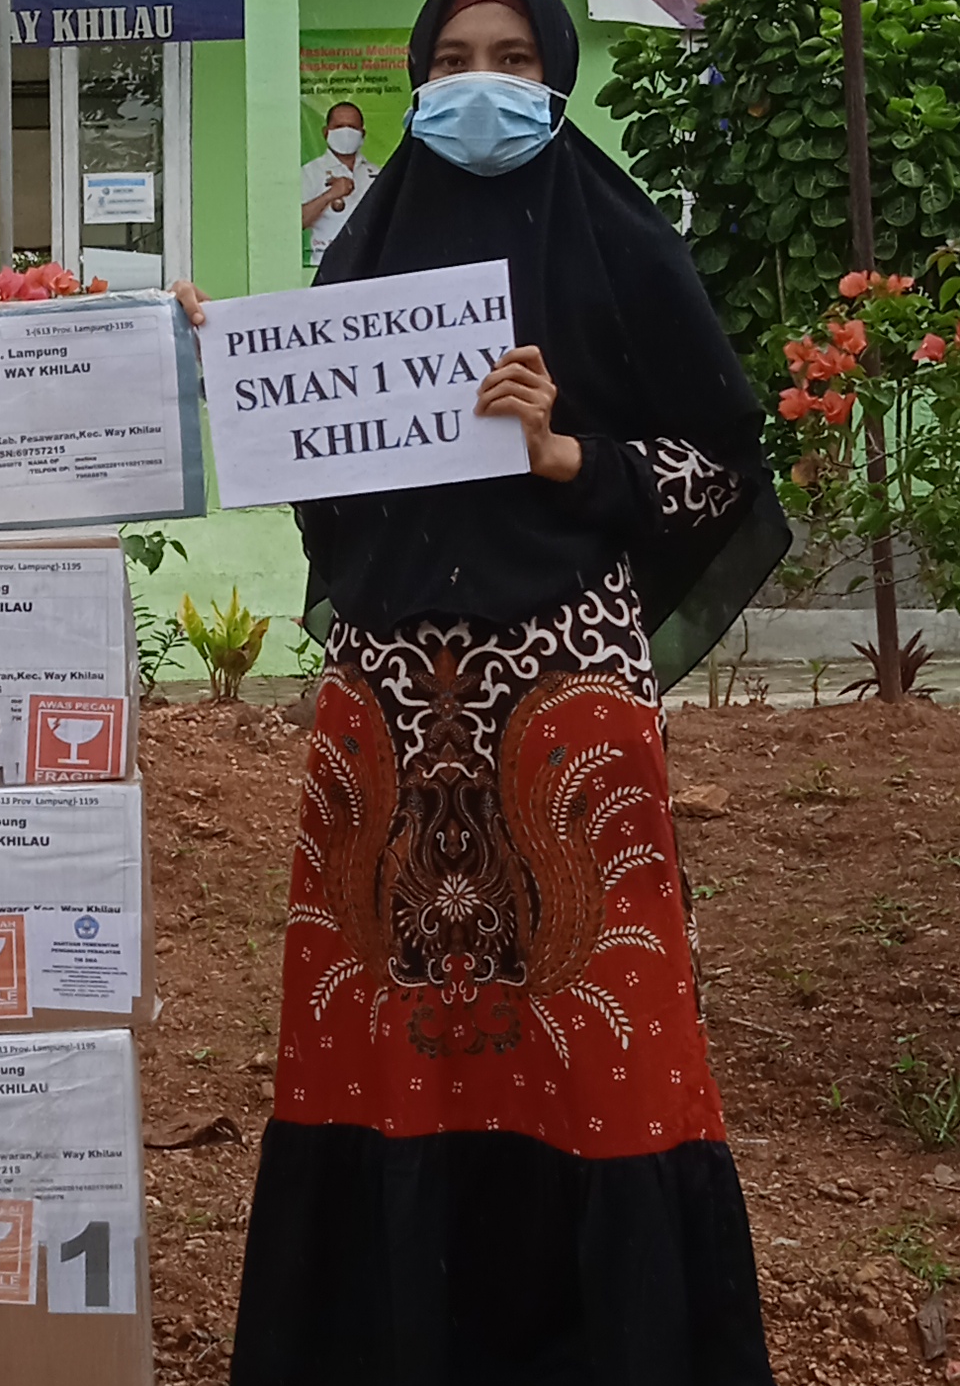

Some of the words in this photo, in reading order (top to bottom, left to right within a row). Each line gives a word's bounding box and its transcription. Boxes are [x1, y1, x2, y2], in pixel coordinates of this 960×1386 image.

[51, 5, 174, 43] KHILAU
[226, 318, 335, 357] PIHAK
[342, 295, 508, 343] SEKOLAH
[8, 346, 68, 362] Lampung
[4, 366, 35, 379] WAY
[39, 363, 91, 377] KHILAU
[235, 364, 362, 412] SMAN
[372, 361, 390, 393] 1
[402, 346, 508, 389] WAY
[104, 428, 126, 438] Way
[129, 426, 162, 435] Khilau
[290, 409, 462, 461] KHILAU
[44, 672, 67, 682] Way
[70, 671, 104, 680] Khilau
[38, 700, 72, 710] AWAS
[62, 1151, 85, 1161] Way
[88, 1150, 122, 1158] Khilau
[60, 1221, 111, 1307] 1
